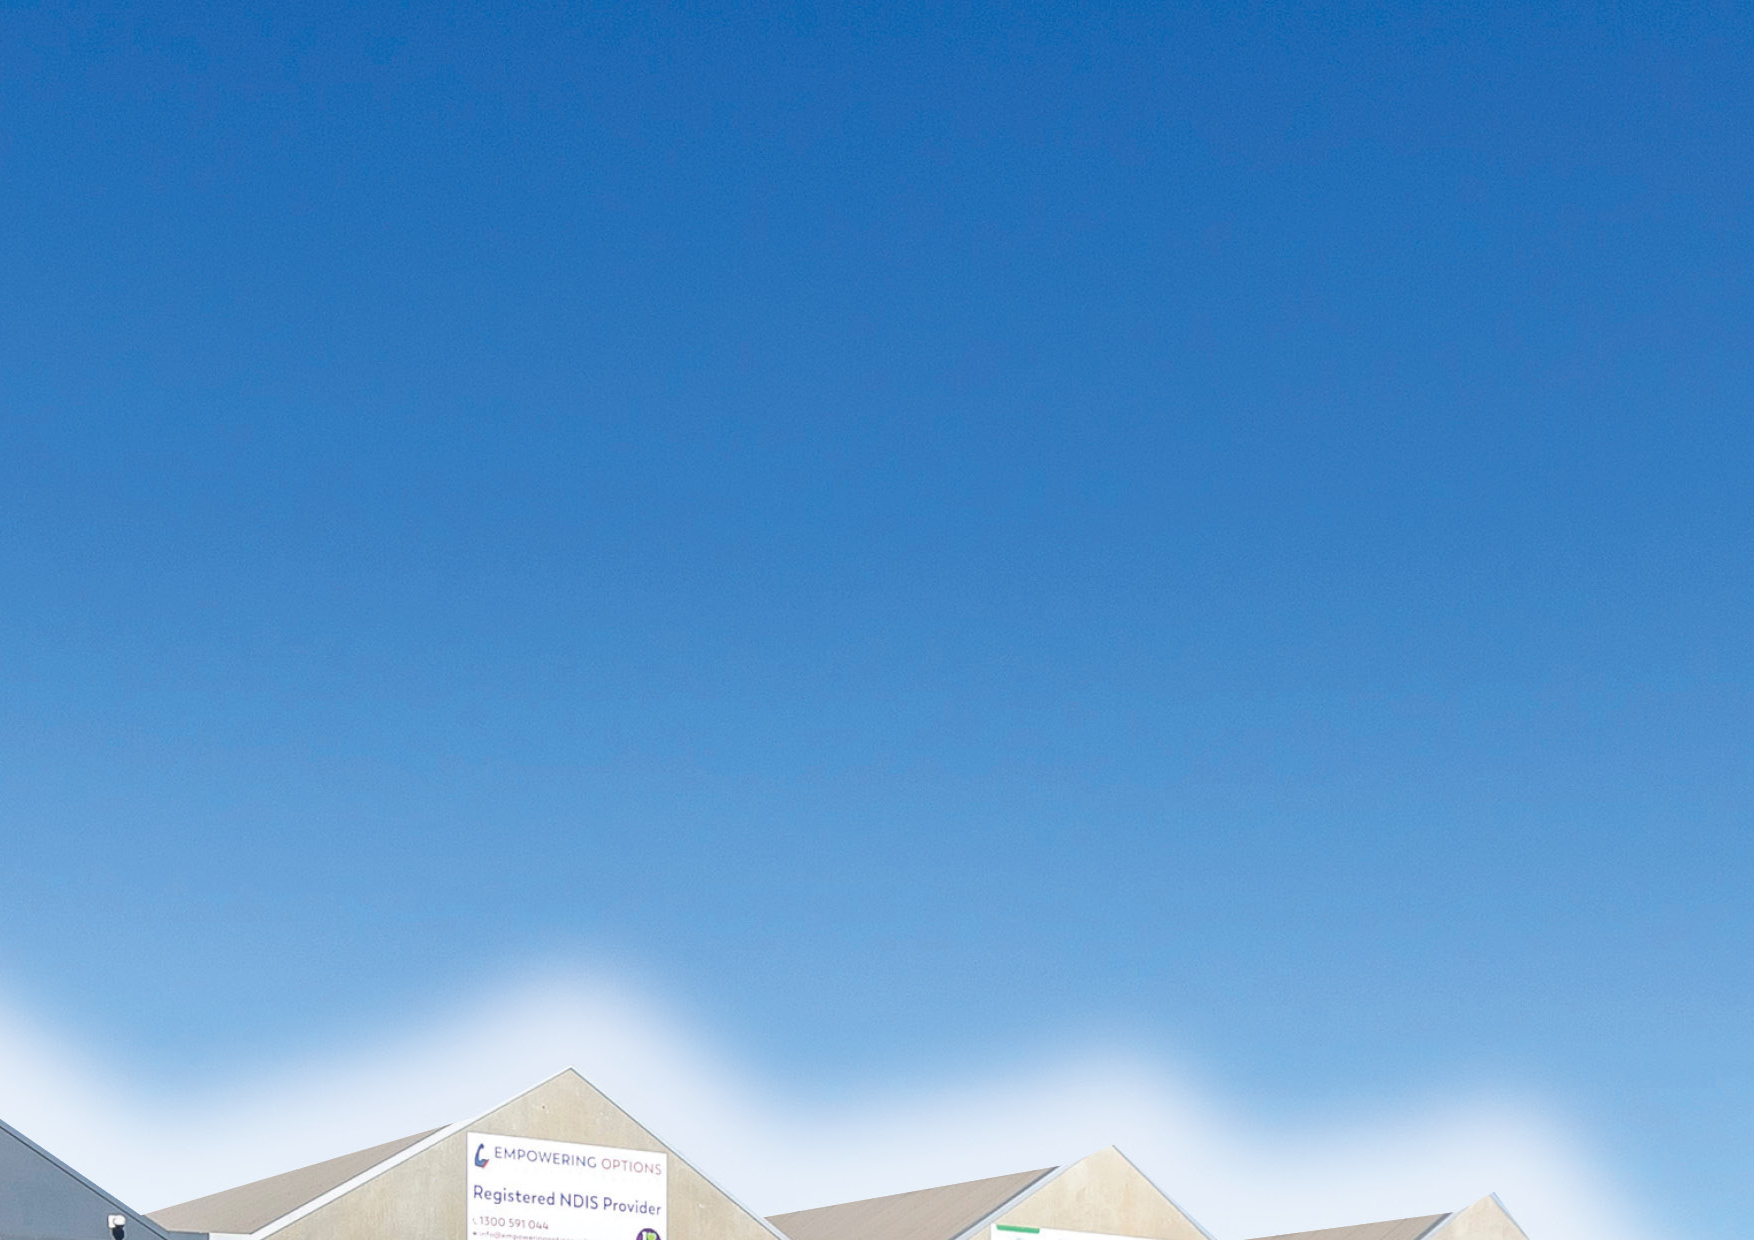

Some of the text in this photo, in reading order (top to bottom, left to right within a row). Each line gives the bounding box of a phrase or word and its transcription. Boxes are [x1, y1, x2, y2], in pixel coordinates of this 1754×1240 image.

[494, 1146, 662, 1176] EMPOWERING OPTIONS
[473, 1184, 662, 1216] Registered NDIS Provider
[479, 1216, 549, 1230] 1300 591 044
